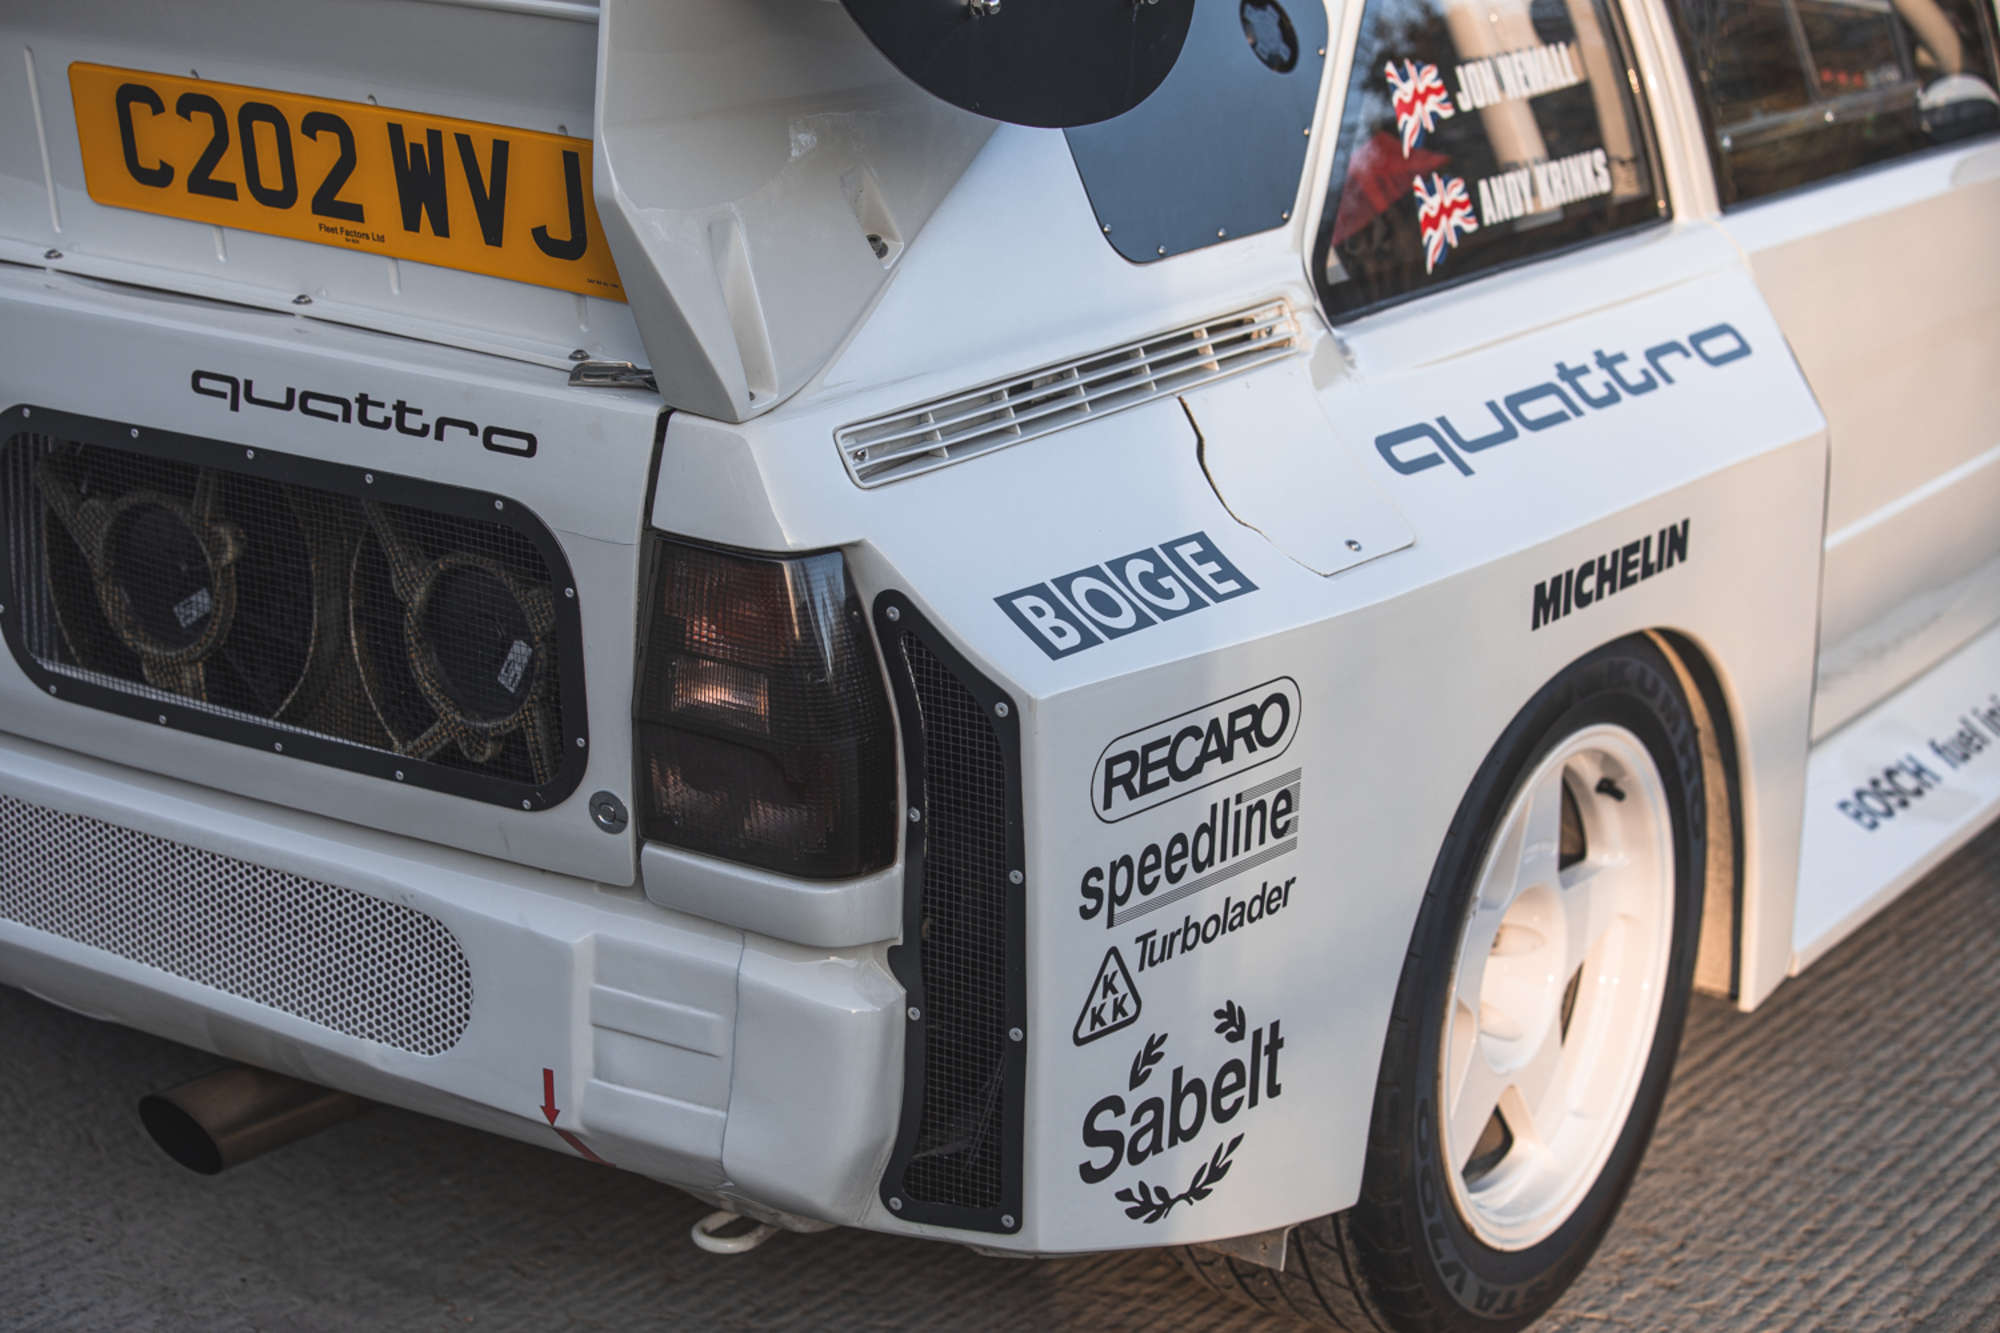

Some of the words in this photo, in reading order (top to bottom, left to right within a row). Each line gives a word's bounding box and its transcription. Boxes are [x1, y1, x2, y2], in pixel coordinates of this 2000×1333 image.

[1455, 59, 1502, 112] JON
[115, 83, 365, 224] C202
[1478, 167, 1534, 227] ANDY
[1534, 148, 1612, 209] KRINKS
[318, 223, 338, 236] Fleet
[340, 226, 370, 240] Factors
[371, 231, 385, 243] Ltd
[191, 368, 538, 459] quattro
[1374, 322, 1753, 477] quattro
[1010, 536, 1248, 655] BOGE
[1530, 517, 1690, 631] MICHELIN
[1103, 692, 1290, 812] RECARO
[1837, 752, 1943, 832] BOSCH
[1926, 714, 1991, 770] fuel
[1079, 788, 1293, 930] speedline
[1134, 876, 1297, 973] Turbolader
[1078, 1019, 1285, 1185] Sabelt
